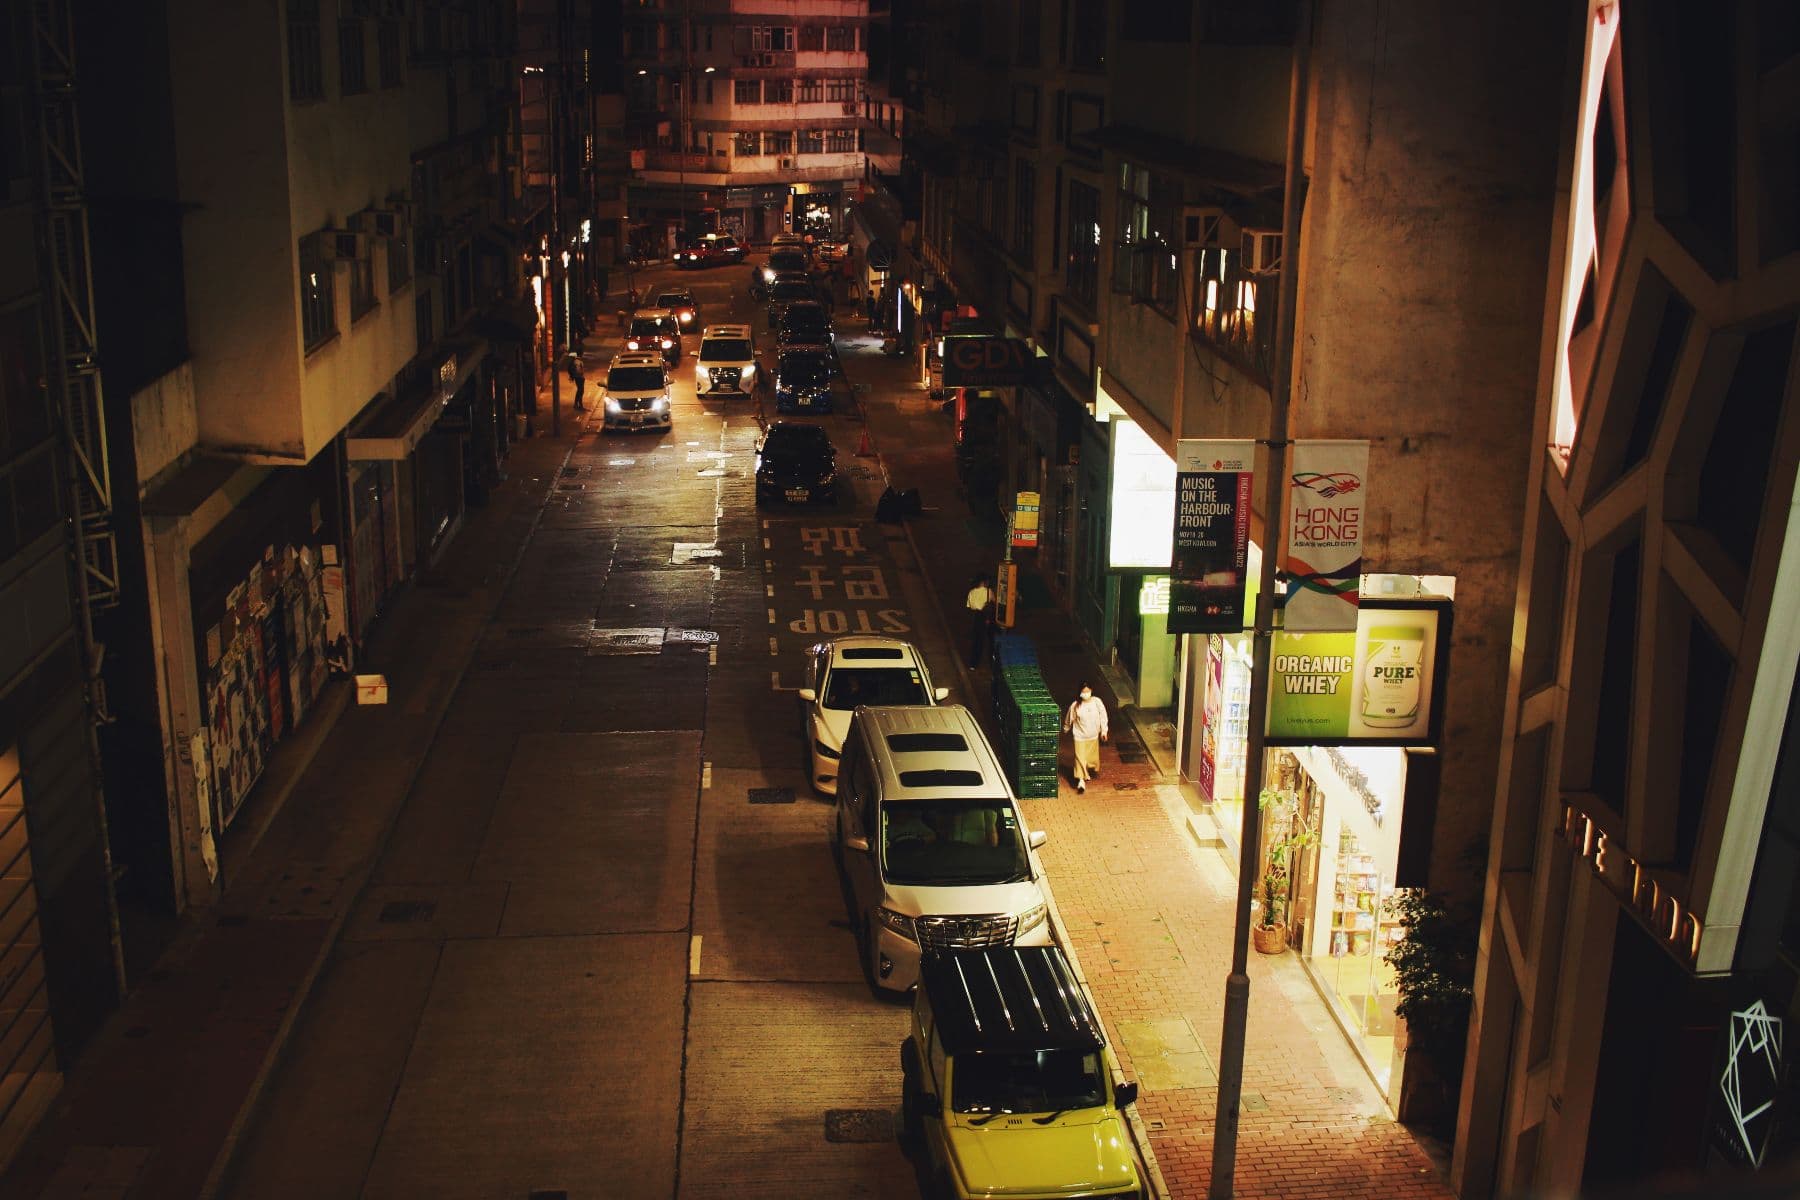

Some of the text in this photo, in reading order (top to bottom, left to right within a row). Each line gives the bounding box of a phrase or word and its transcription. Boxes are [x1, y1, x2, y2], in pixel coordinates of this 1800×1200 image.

[1182, 478, 1215, 490] MUSIC
[1181, 490, 1217, 502] ON THE
[1238, 500, 1247, 522] MUSIC
[1295, 508, 1360, 523] HONG
[1179, 515, 1213, 528] FRONT
[1294, 525, 1358, 541] KONG
[1236, 551, 1245, 568] 2022
[789, 609, 912, 634] STOP
[1275, 655, 1353, 673] ORGANIC
[1373, 667, 1415, 679] PURE
[1284, 675, 1341, 694] WHEY
